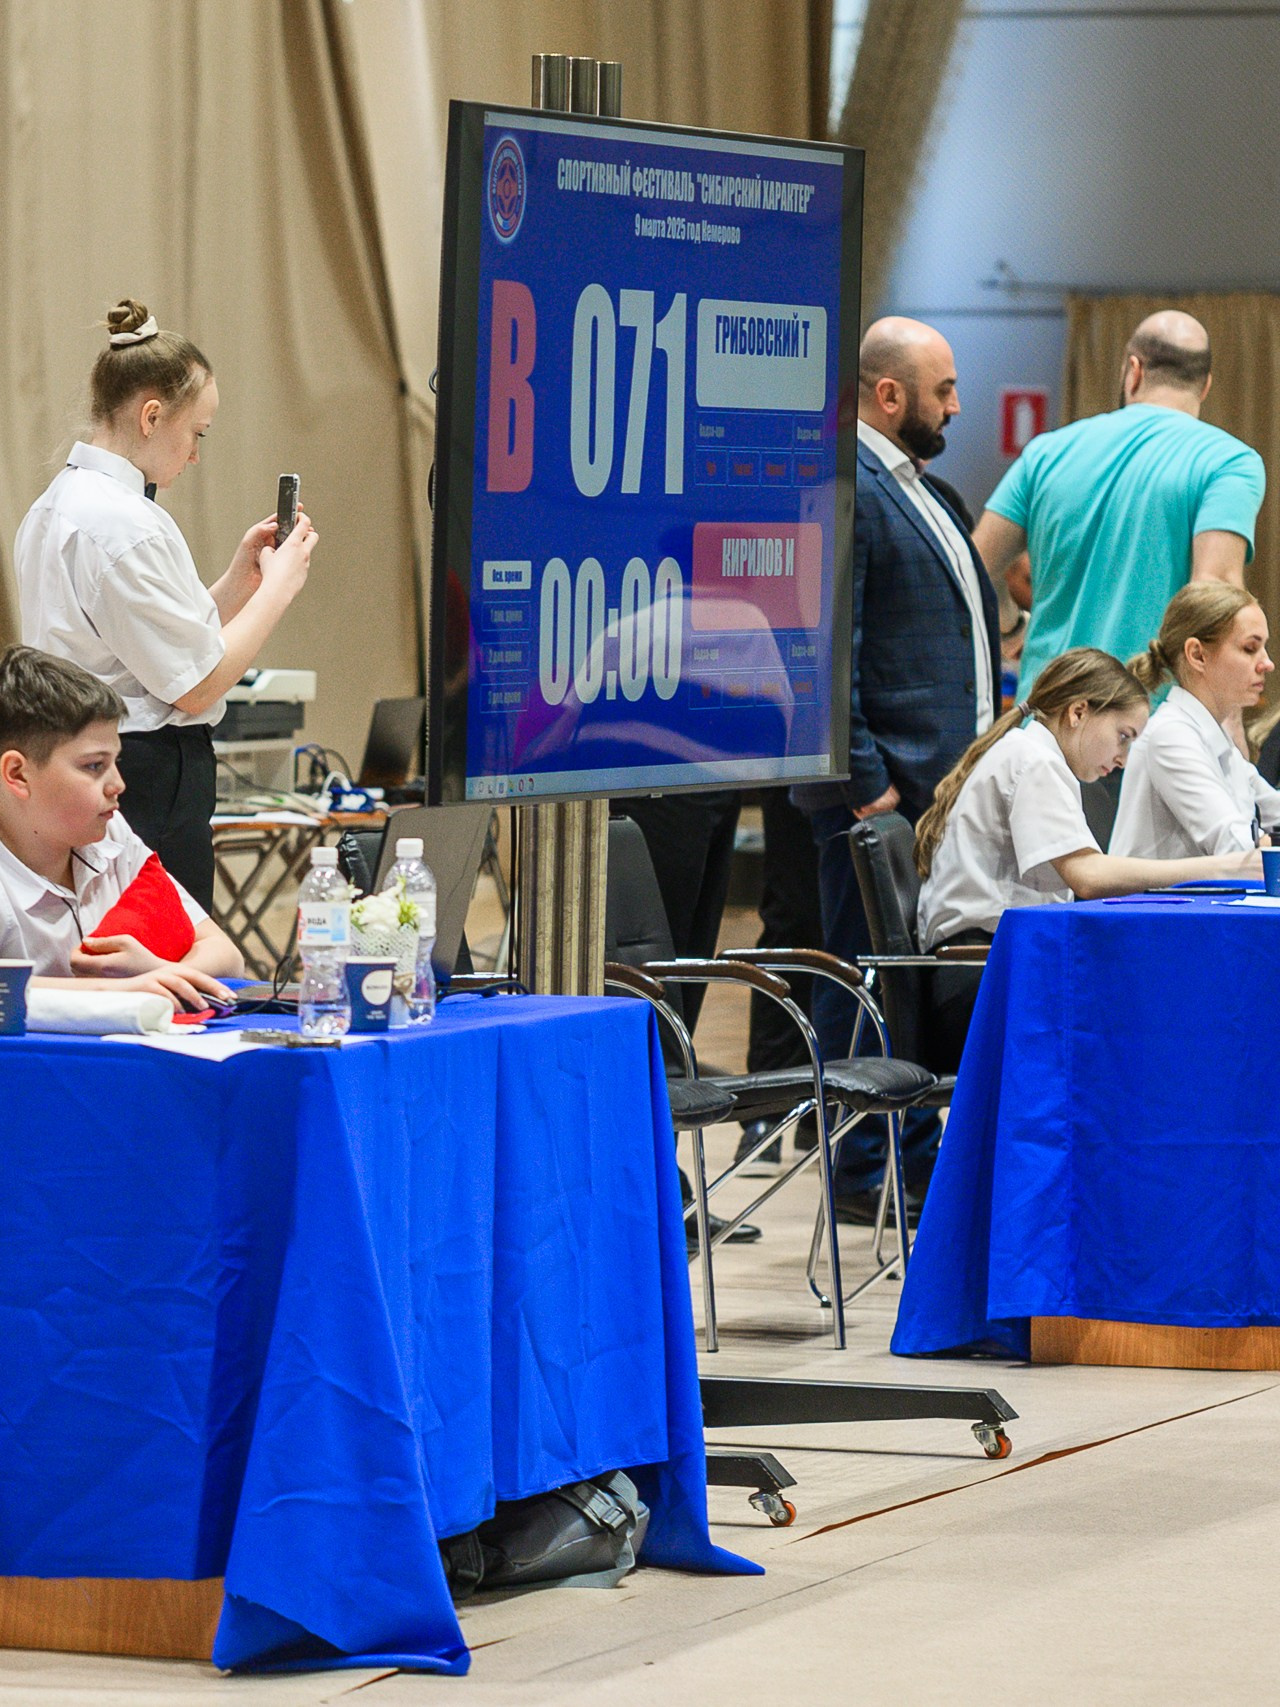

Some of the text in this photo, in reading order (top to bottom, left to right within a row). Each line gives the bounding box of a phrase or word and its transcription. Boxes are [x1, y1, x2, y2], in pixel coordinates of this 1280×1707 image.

[557, 158, 631, 196] СПОРТИВНЫЙ
[632, 166, 695, 202] ФЕСТИВАЛЬ
[696, 172, 761, 209] "СИБИРСКИЙ
[762, 180, 815, 213] ХАРАКТЕР"
[634, 213, 741, 245] 9 марта 2025 год Кемерово
[715, 311, 800, 358] ГРИБОВСКИЙ
[570, 283, 687, 497] 071
[722, 537, 796, 577] КИРИЛОВ И
[539, 557, 683, 706] 00:00
